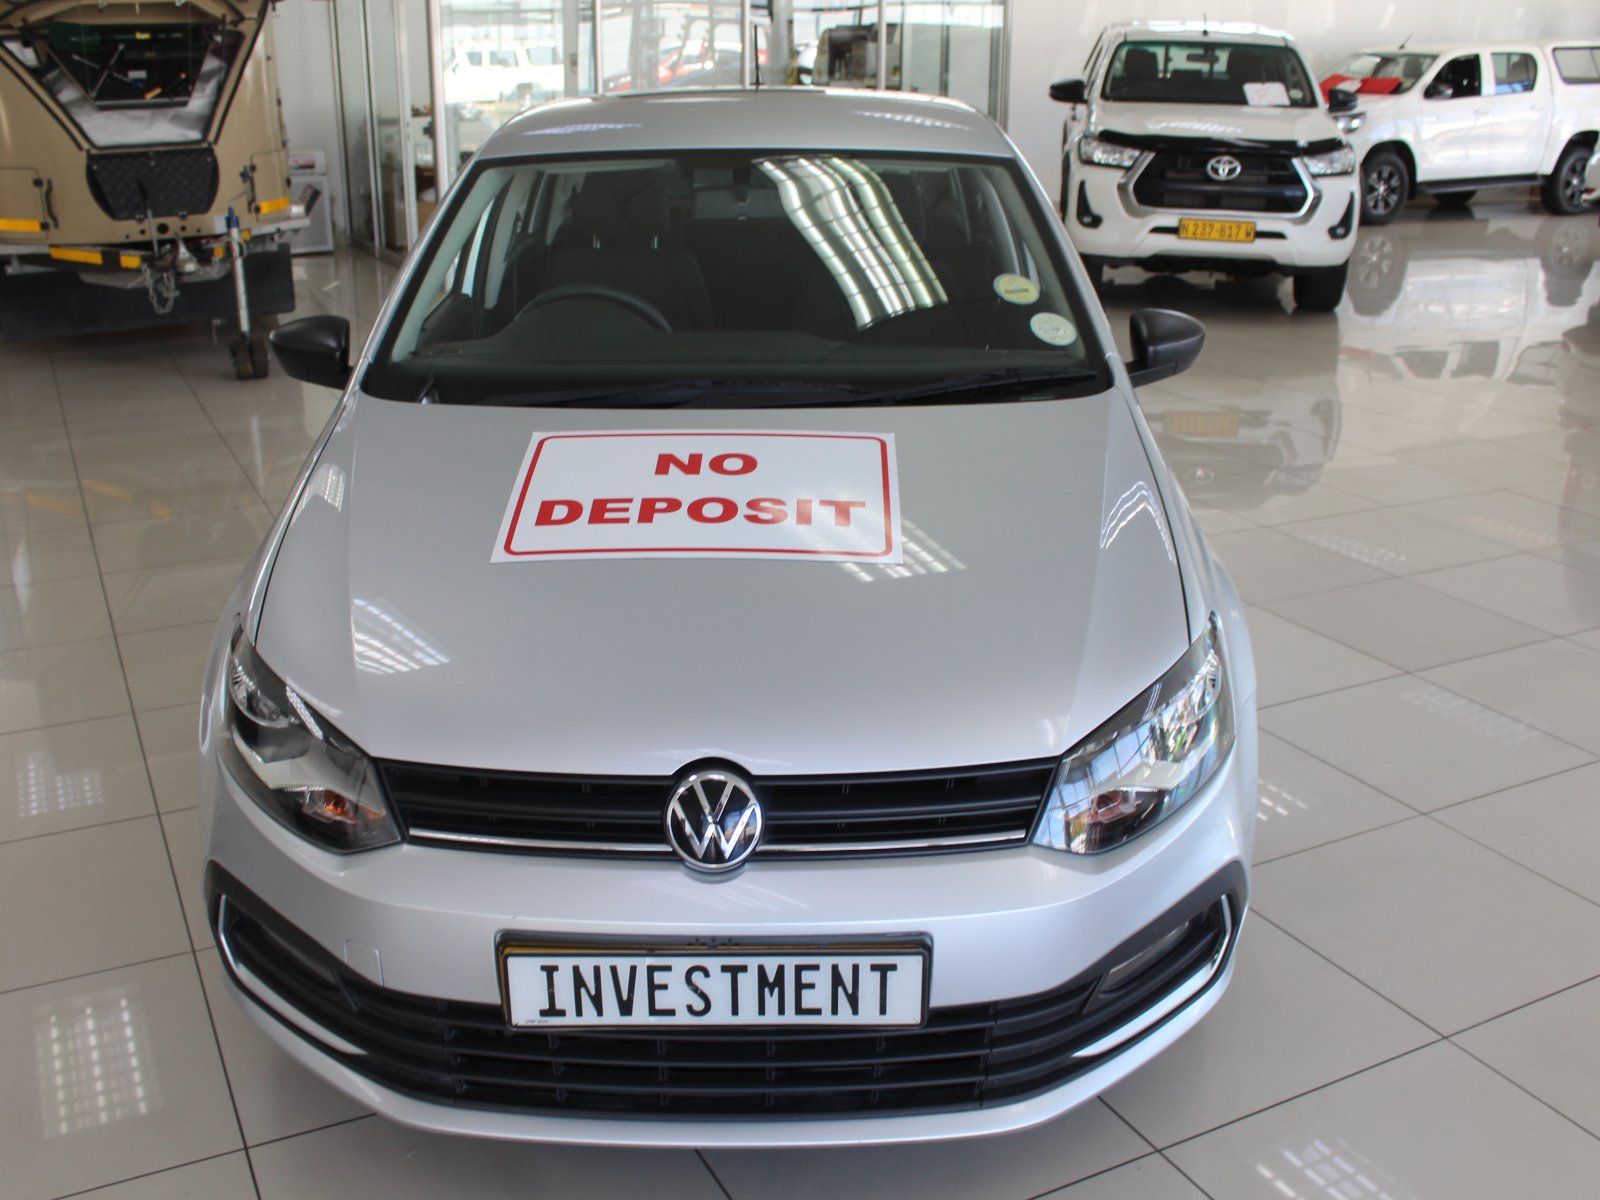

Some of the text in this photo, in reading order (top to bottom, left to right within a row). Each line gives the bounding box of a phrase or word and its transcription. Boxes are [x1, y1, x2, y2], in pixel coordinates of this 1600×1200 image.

[654, 453, 758, 475] NO
[535, 497, 866, 526] DEPOSIT
[671, 779, 758, 861] VW
[539, 964, 898, 1018] INVESTMENT
